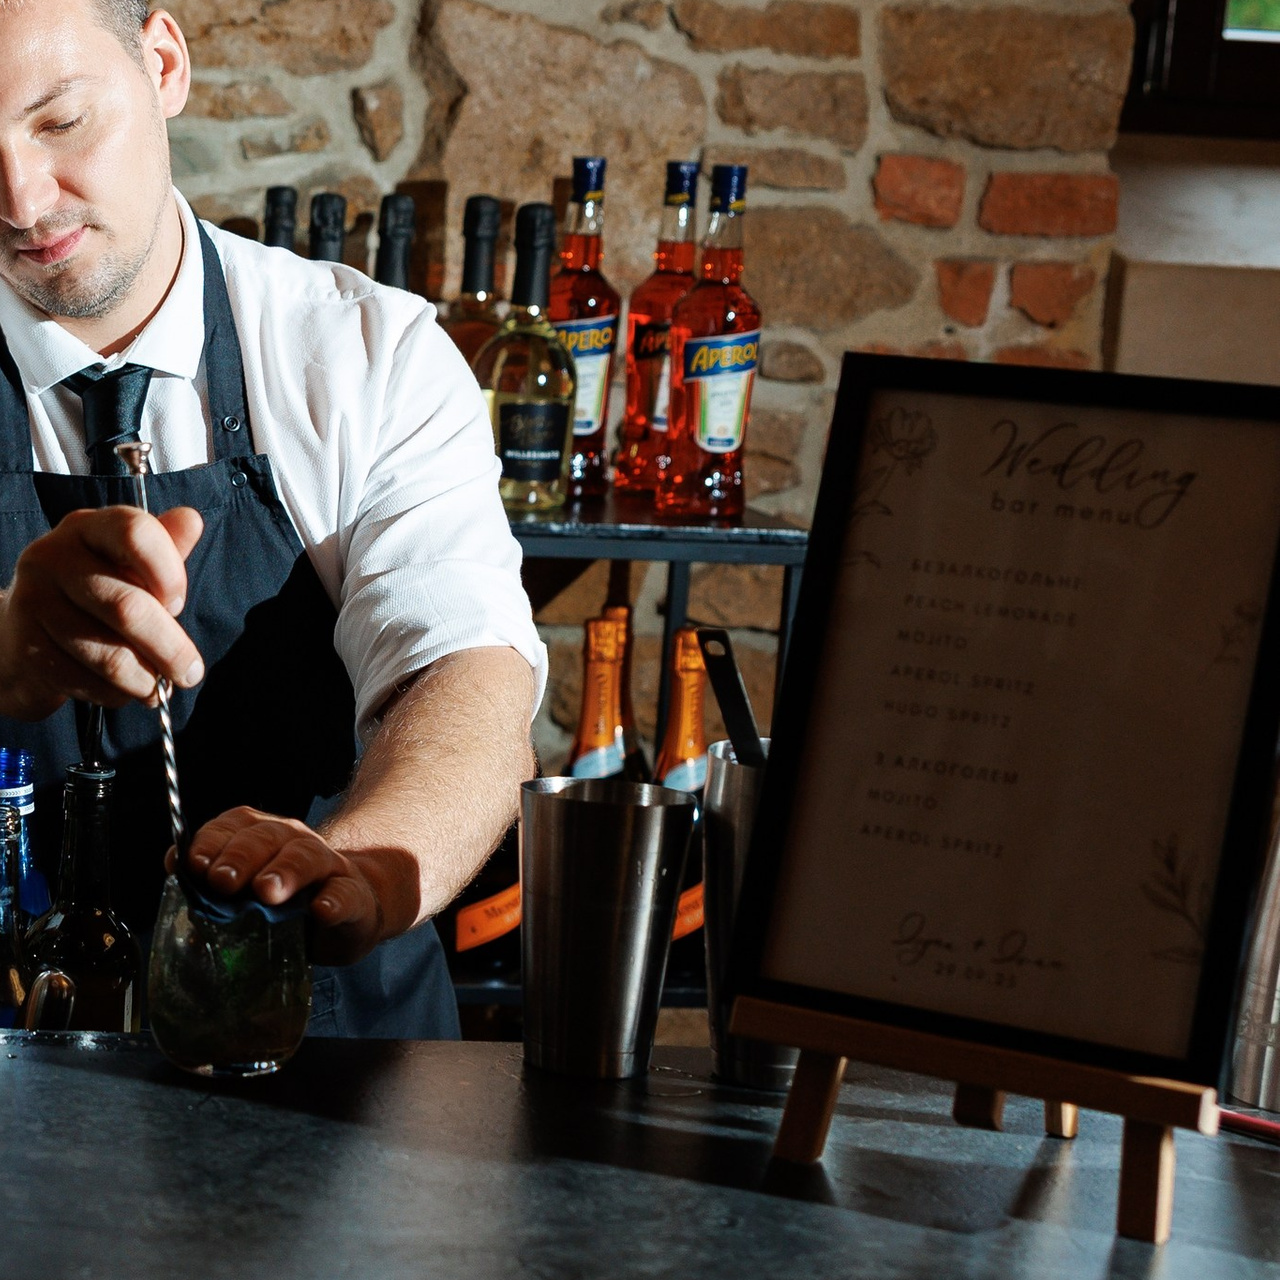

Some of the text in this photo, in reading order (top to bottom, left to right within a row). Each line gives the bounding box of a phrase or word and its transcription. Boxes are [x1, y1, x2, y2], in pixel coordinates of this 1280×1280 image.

[557, 326, 613, 351] APERO
[980, 419, 1198, 530] Wedding
[991, 492, 1135, 525] bar menu
[902, 594, 1078, 628] PEACH LEMONADE
[896, 630, 968, 651] MOJITO
[890, 664, 1035, 697] APEROL SPRITZ
[883, 700, 1011, 729] HUGO SPRITZ
[867, 787, 939, 811] MOJITO
[859, 823, 1004, 859] APEROL SPRITZ
